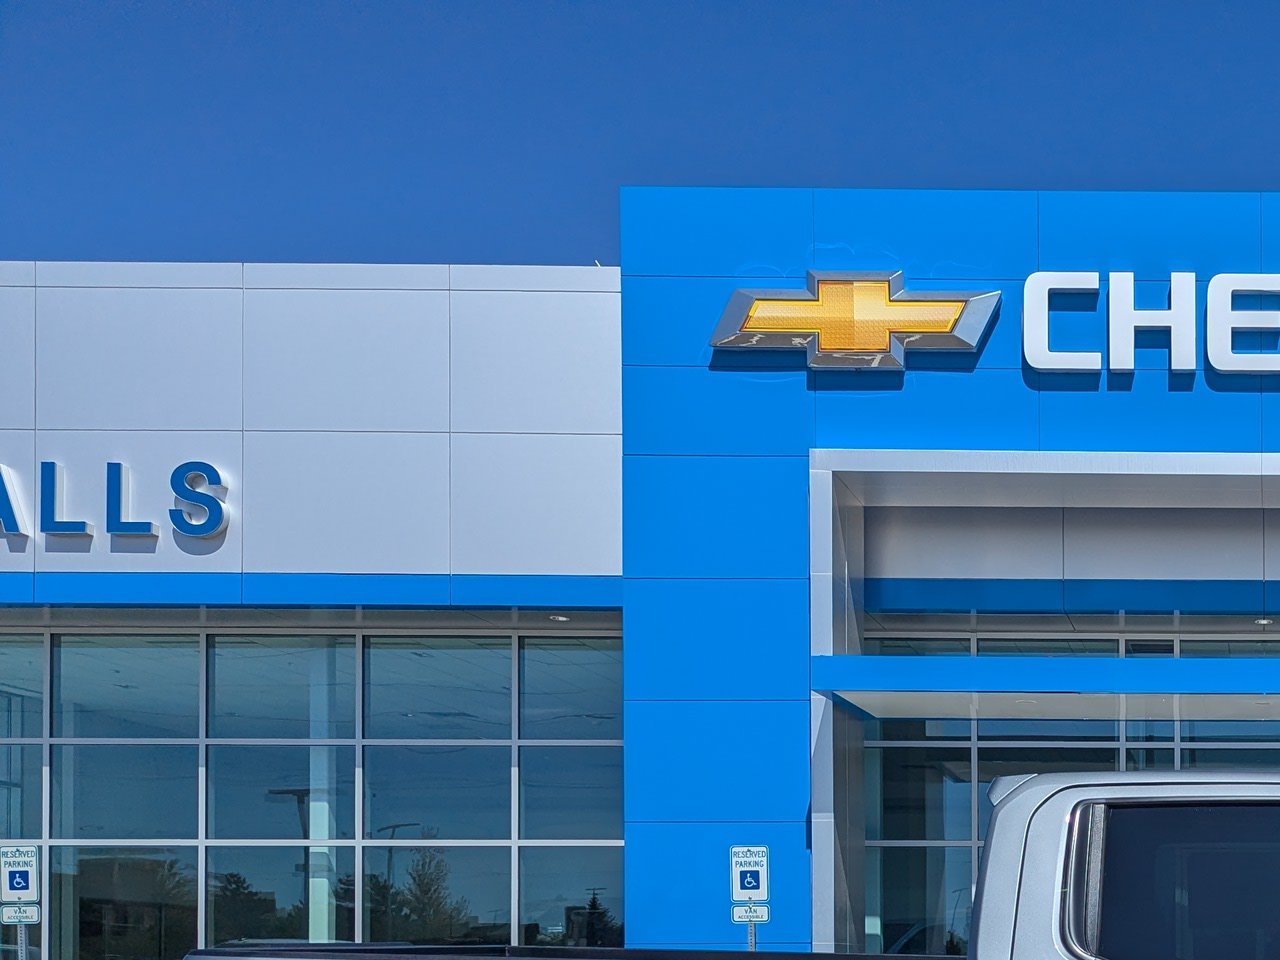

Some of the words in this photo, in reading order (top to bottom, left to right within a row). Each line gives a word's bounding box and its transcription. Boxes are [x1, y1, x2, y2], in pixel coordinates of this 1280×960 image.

[1, 850, 36, 859] RESERVED
[732, 850, 766, 859] RESERVED
[3, 860, 34, 868] PARKING
[735, 860, 764, 868] PARKING
